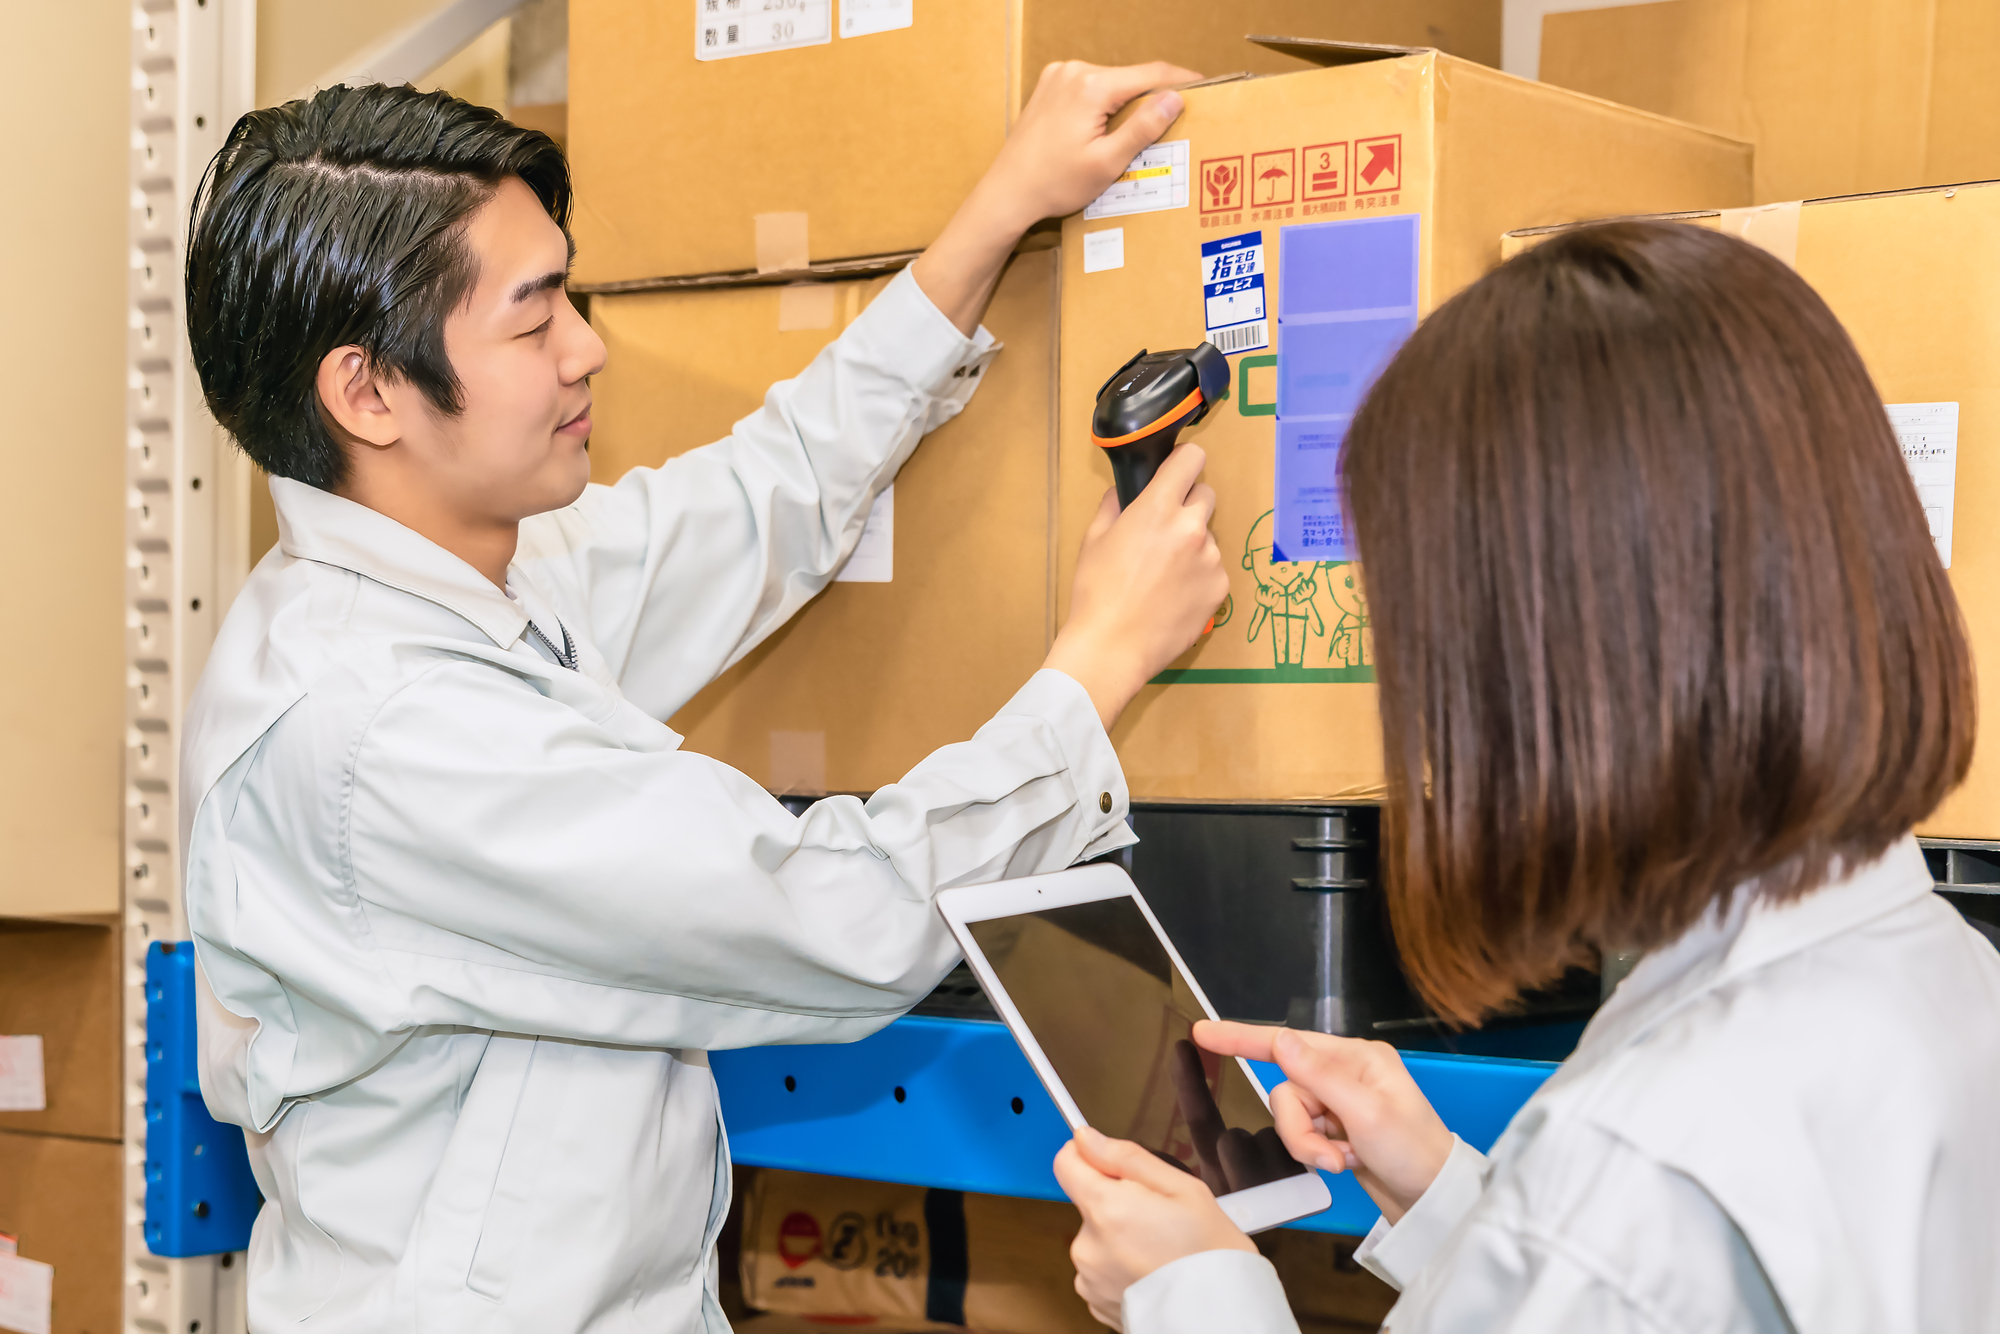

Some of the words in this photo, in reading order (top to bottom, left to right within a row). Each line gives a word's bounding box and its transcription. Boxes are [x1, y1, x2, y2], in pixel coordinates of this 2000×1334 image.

[704, 24, 739, 47] 数量
[771, 20, 795, 42] 30
[1319, 151, 1331, 170] 3
[1214, 277, 1253, 295] サービス
[1302, 528, 1345, 537] スマートクラ
